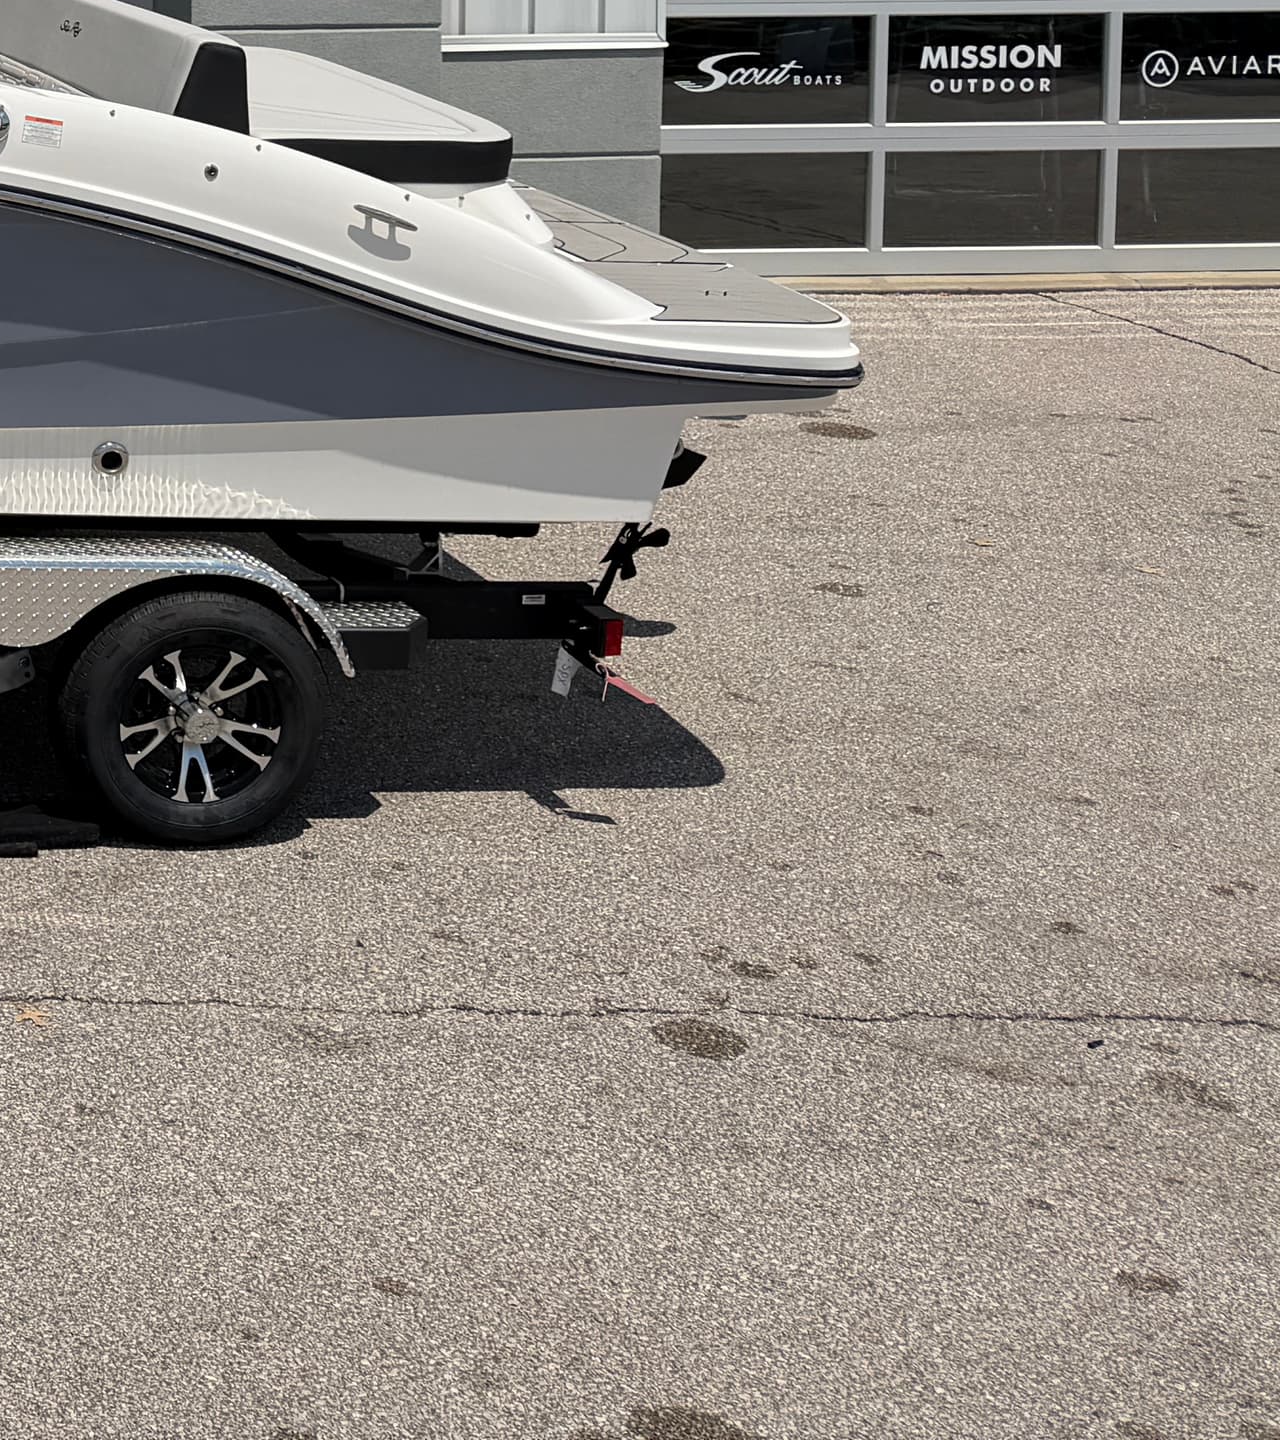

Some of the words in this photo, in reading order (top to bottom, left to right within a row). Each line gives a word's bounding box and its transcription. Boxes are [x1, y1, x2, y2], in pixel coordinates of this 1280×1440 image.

[920, 44, 1062, 69] MISSION
[674, 51, 803, 93] Scout
[793, 75, 842, 85] BOATS
[930, 78, 1051, 93] OUTDOOR
